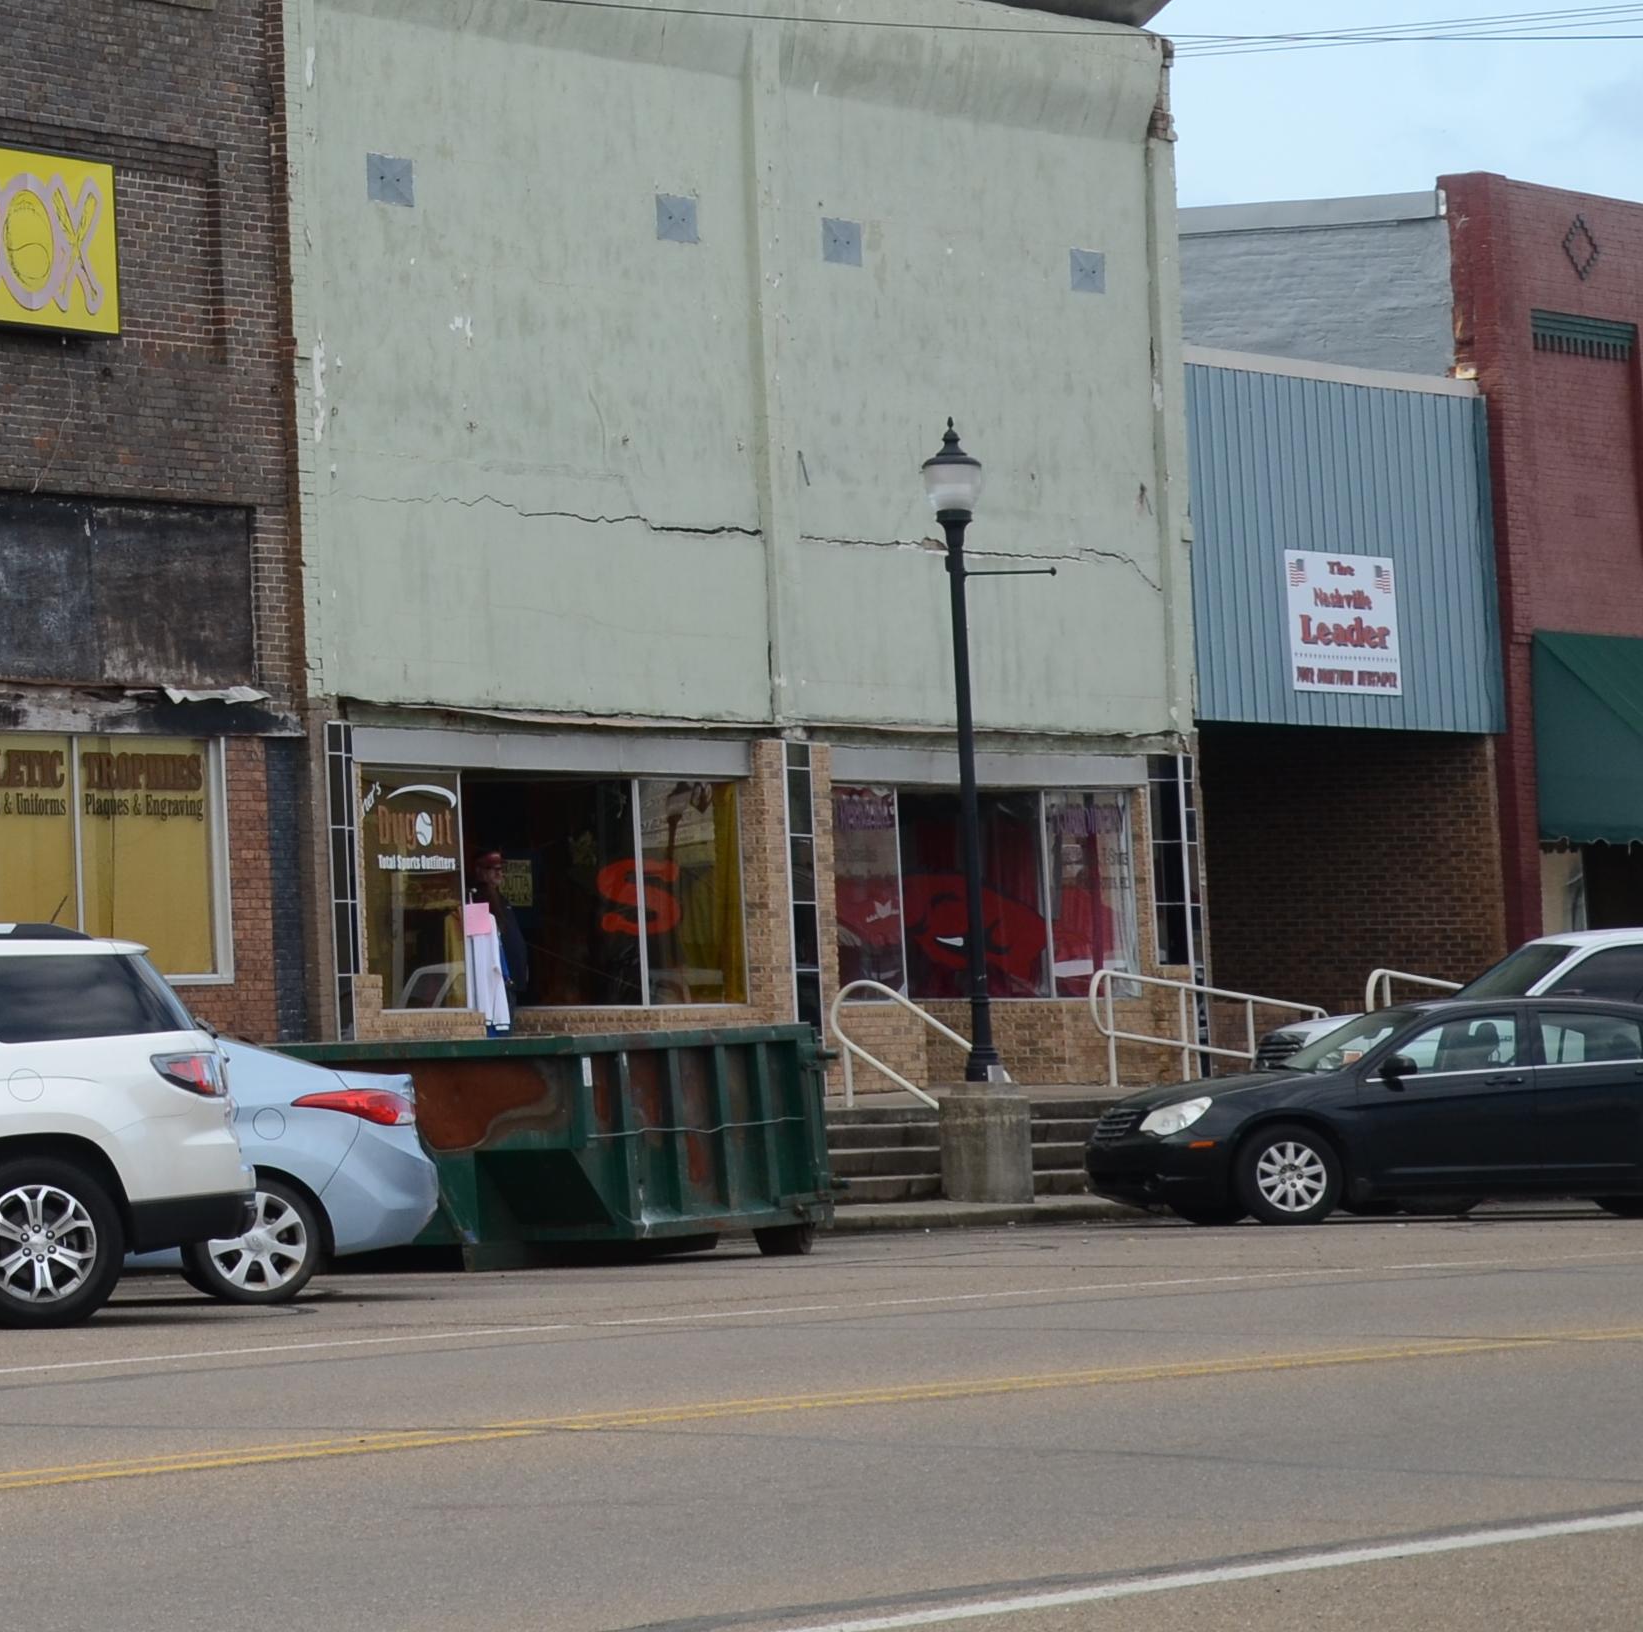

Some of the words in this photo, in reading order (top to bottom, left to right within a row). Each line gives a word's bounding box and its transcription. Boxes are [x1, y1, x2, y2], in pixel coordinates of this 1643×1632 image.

[1327, 561, 1355, 576] The
[1313, 587, 1372, 610] Nashville
[1299, 614, 1390, 649] Leader
[82, 752, 203, 791] TROPHIES
[4, 792, 13, 815] &
[16, 792, 66, 816] Uniforms
[85, 793, 130, 820] Plaques
[133, 793, 142, 816] &
[145, 794, 204, 822] Engraving
[377, 854, 397, 870] Total
[397, 854, 421, 871] Sports
